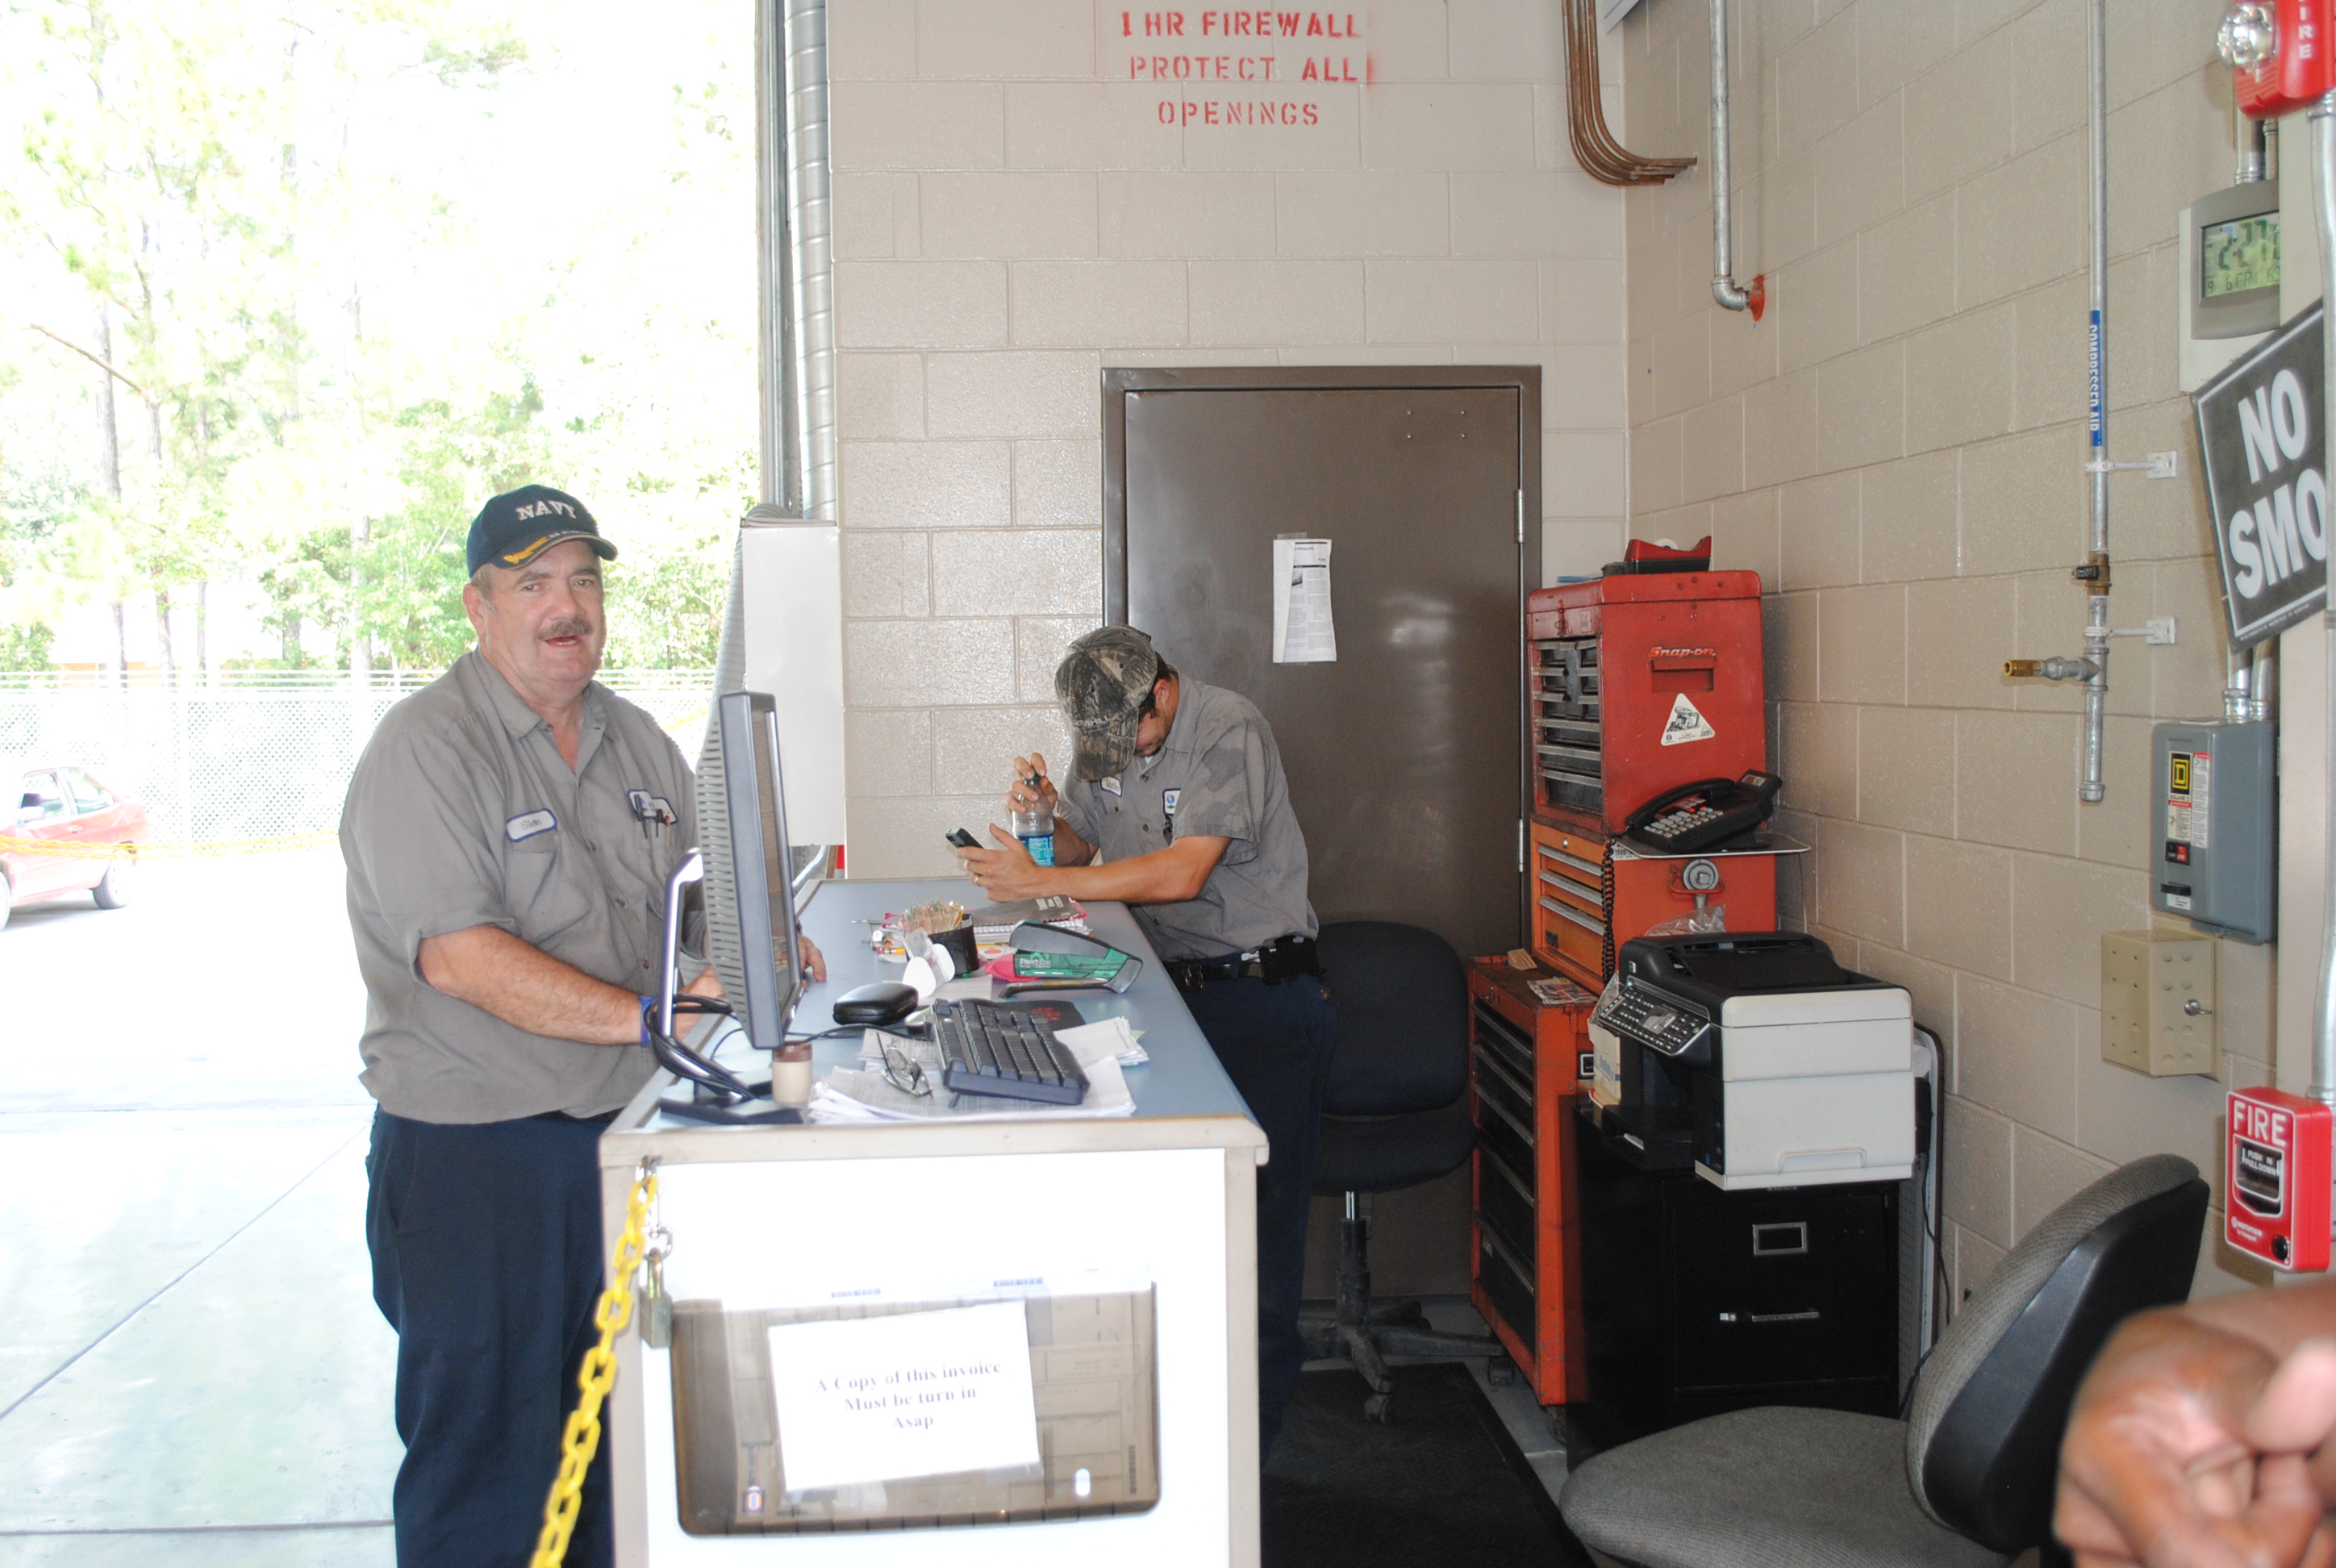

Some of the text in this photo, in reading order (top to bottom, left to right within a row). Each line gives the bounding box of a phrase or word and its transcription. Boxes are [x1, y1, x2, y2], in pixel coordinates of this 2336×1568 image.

[1145, 12, 1184, 37] HR
[1203, 11, 1362, 38] FIREWALL
[2299, 0, 2313, 59] IRE
[1130, 56, 1358, 82] PROTECT ALL
[1158, 101, 1319, 127] OPENINGS
[2089, 411, 2100, 432] AIR
[2238, 369, 2307, 484] NO
[516, 499, 577, 521] NAVY
[1648, 646, 1715, 658] Snap-on
[2234, 1099, 2286, 1146] FIRE
[2245, 1158, 2276, 1176] PULL DOWN
[2247, 1149, 2273, 1166] PUSH IN
[816, 1361, 1001, 1392] A Copy of this invoice
[845, 1386, 976, 1412] Must be turn in
[893, 1416, 934, 1430] Asap
